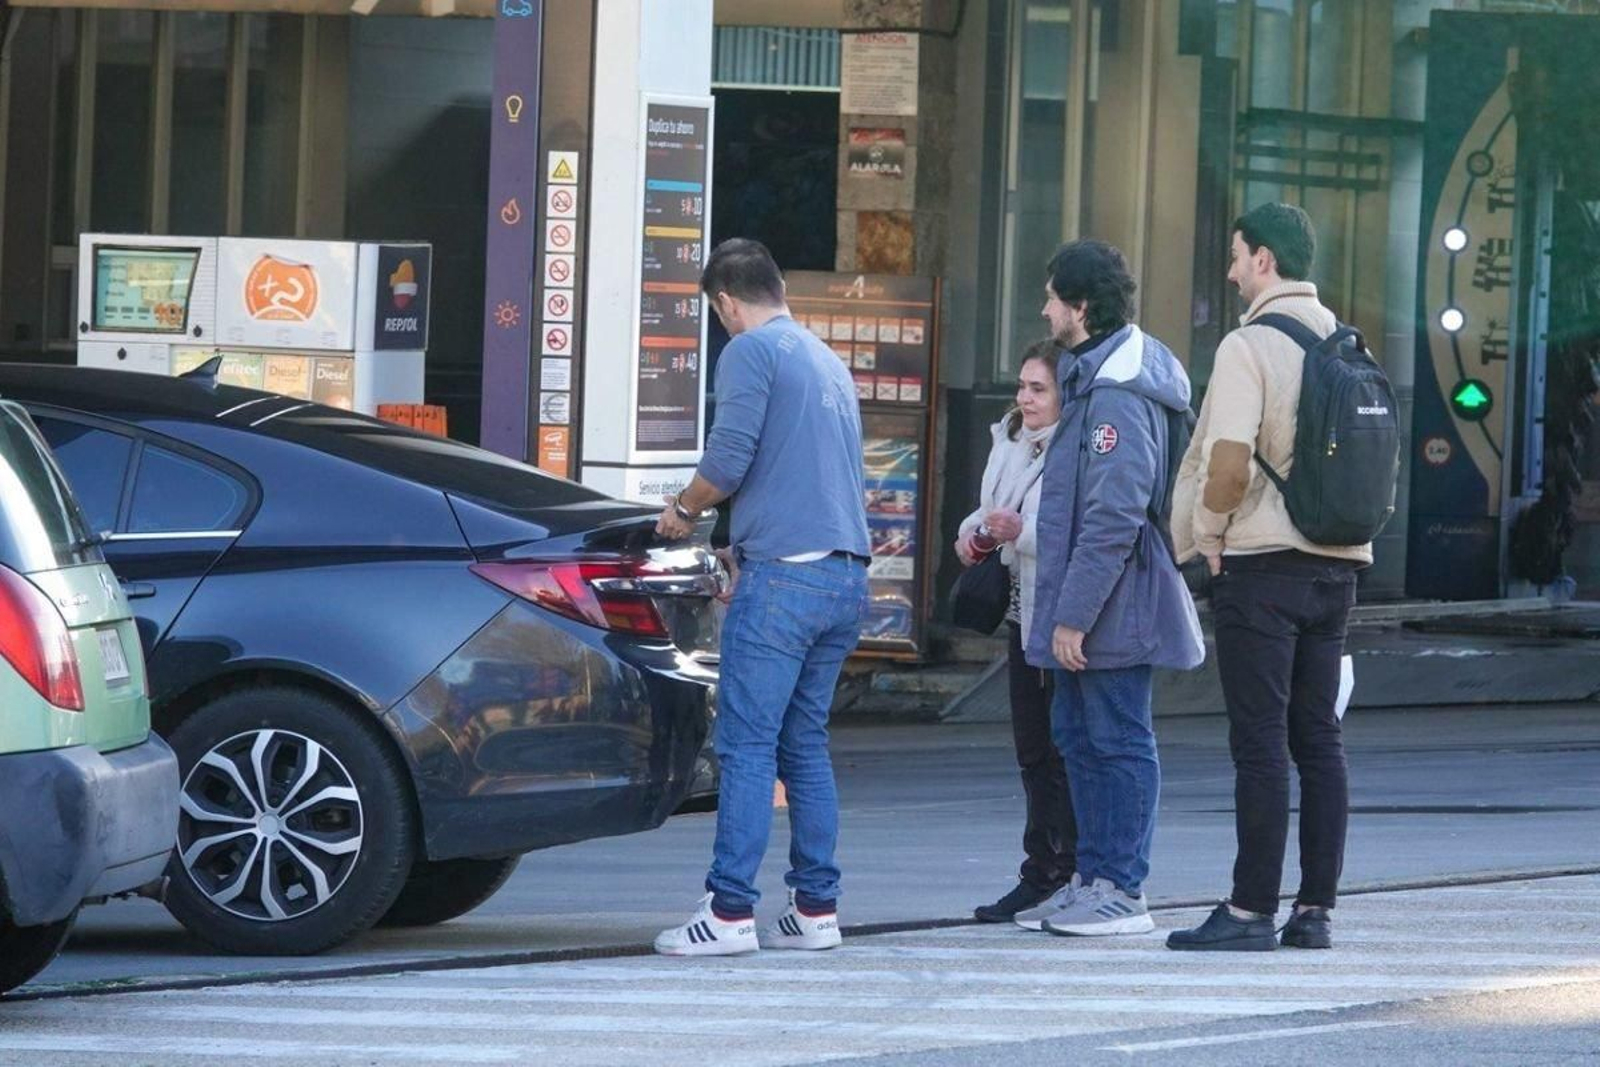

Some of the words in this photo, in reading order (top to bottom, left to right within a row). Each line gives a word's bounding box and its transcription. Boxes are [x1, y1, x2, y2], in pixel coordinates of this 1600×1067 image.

[648, 117, 670, 136] Duplica
[385, 317, 418, 331] REPSOL
[316, 366, 349, 381] Diesel
[639, 479, 660, 496] Servicio
